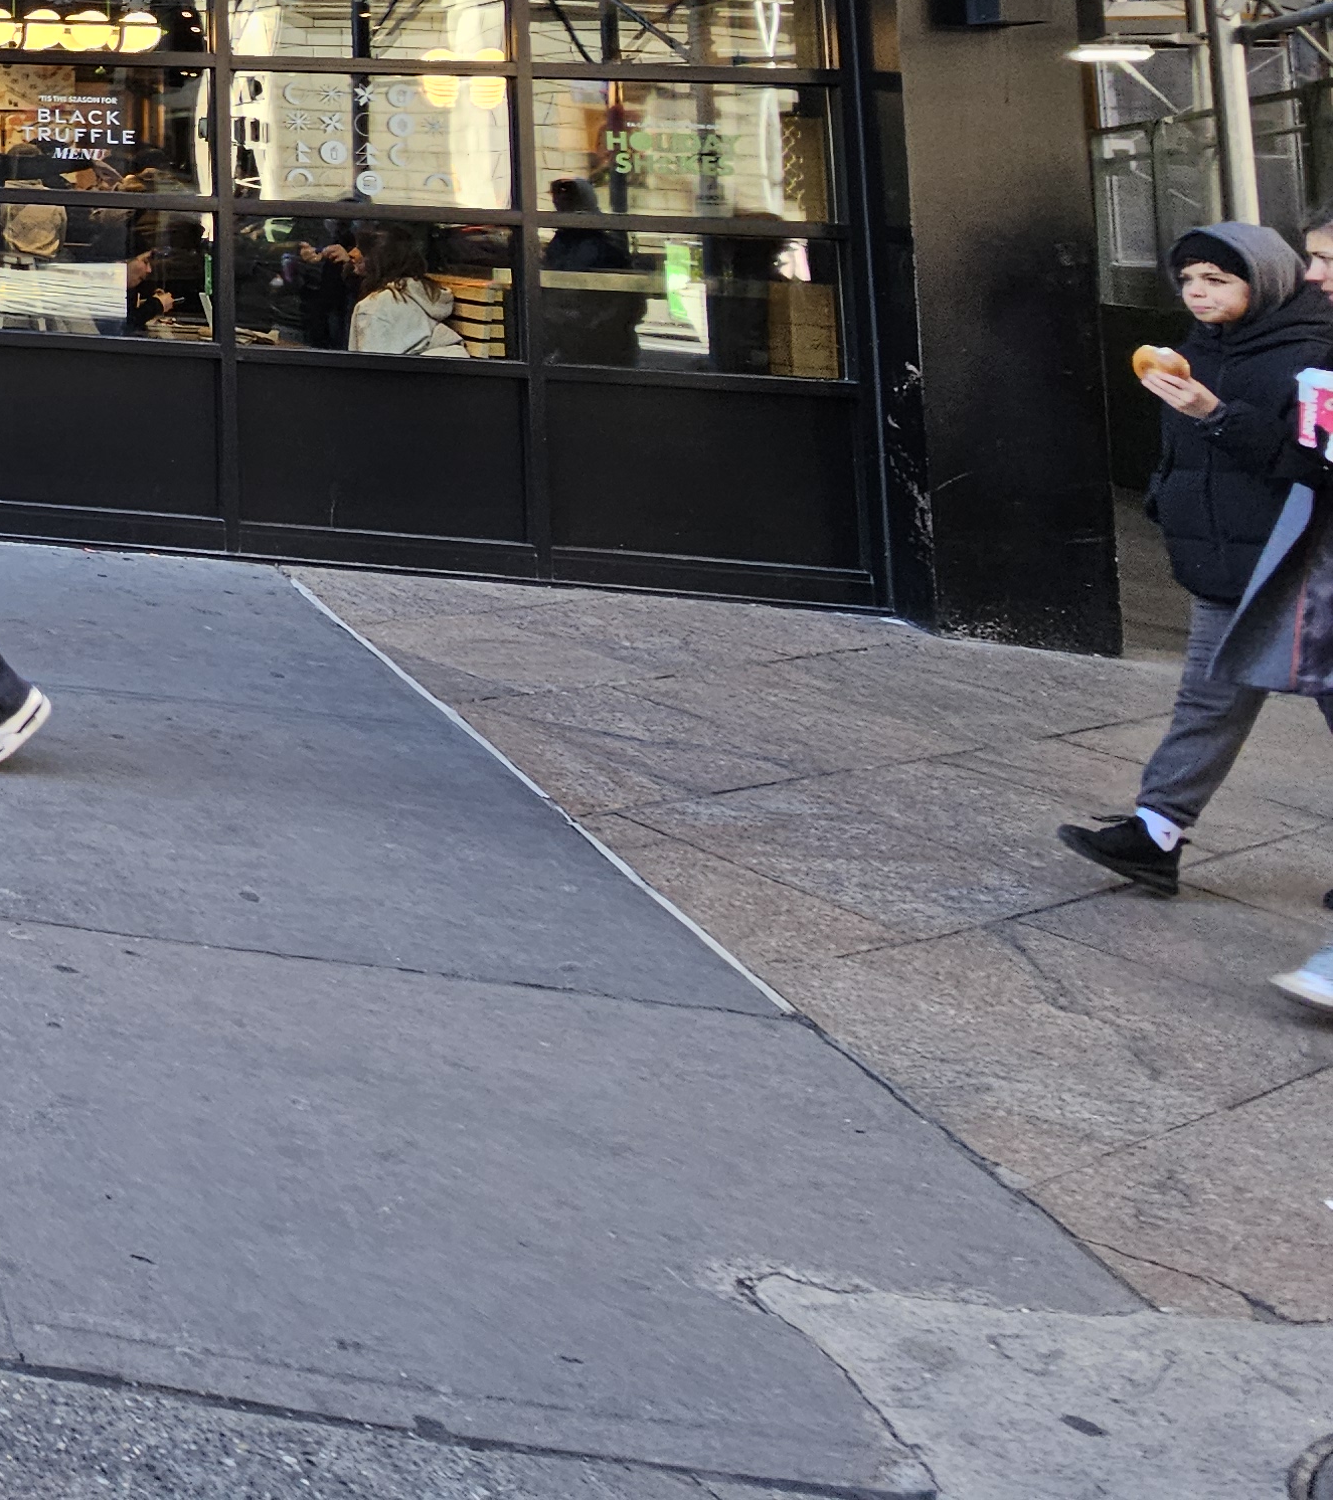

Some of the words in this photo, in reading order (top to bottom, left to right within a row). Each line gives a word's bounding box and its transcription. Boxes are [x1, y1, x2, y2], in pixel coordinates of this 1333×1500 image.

[37, 108, 121, 125] BLACK
[21, 126, 136, 145] TRUFFLE
[51, 147, 106, 161] MENU
